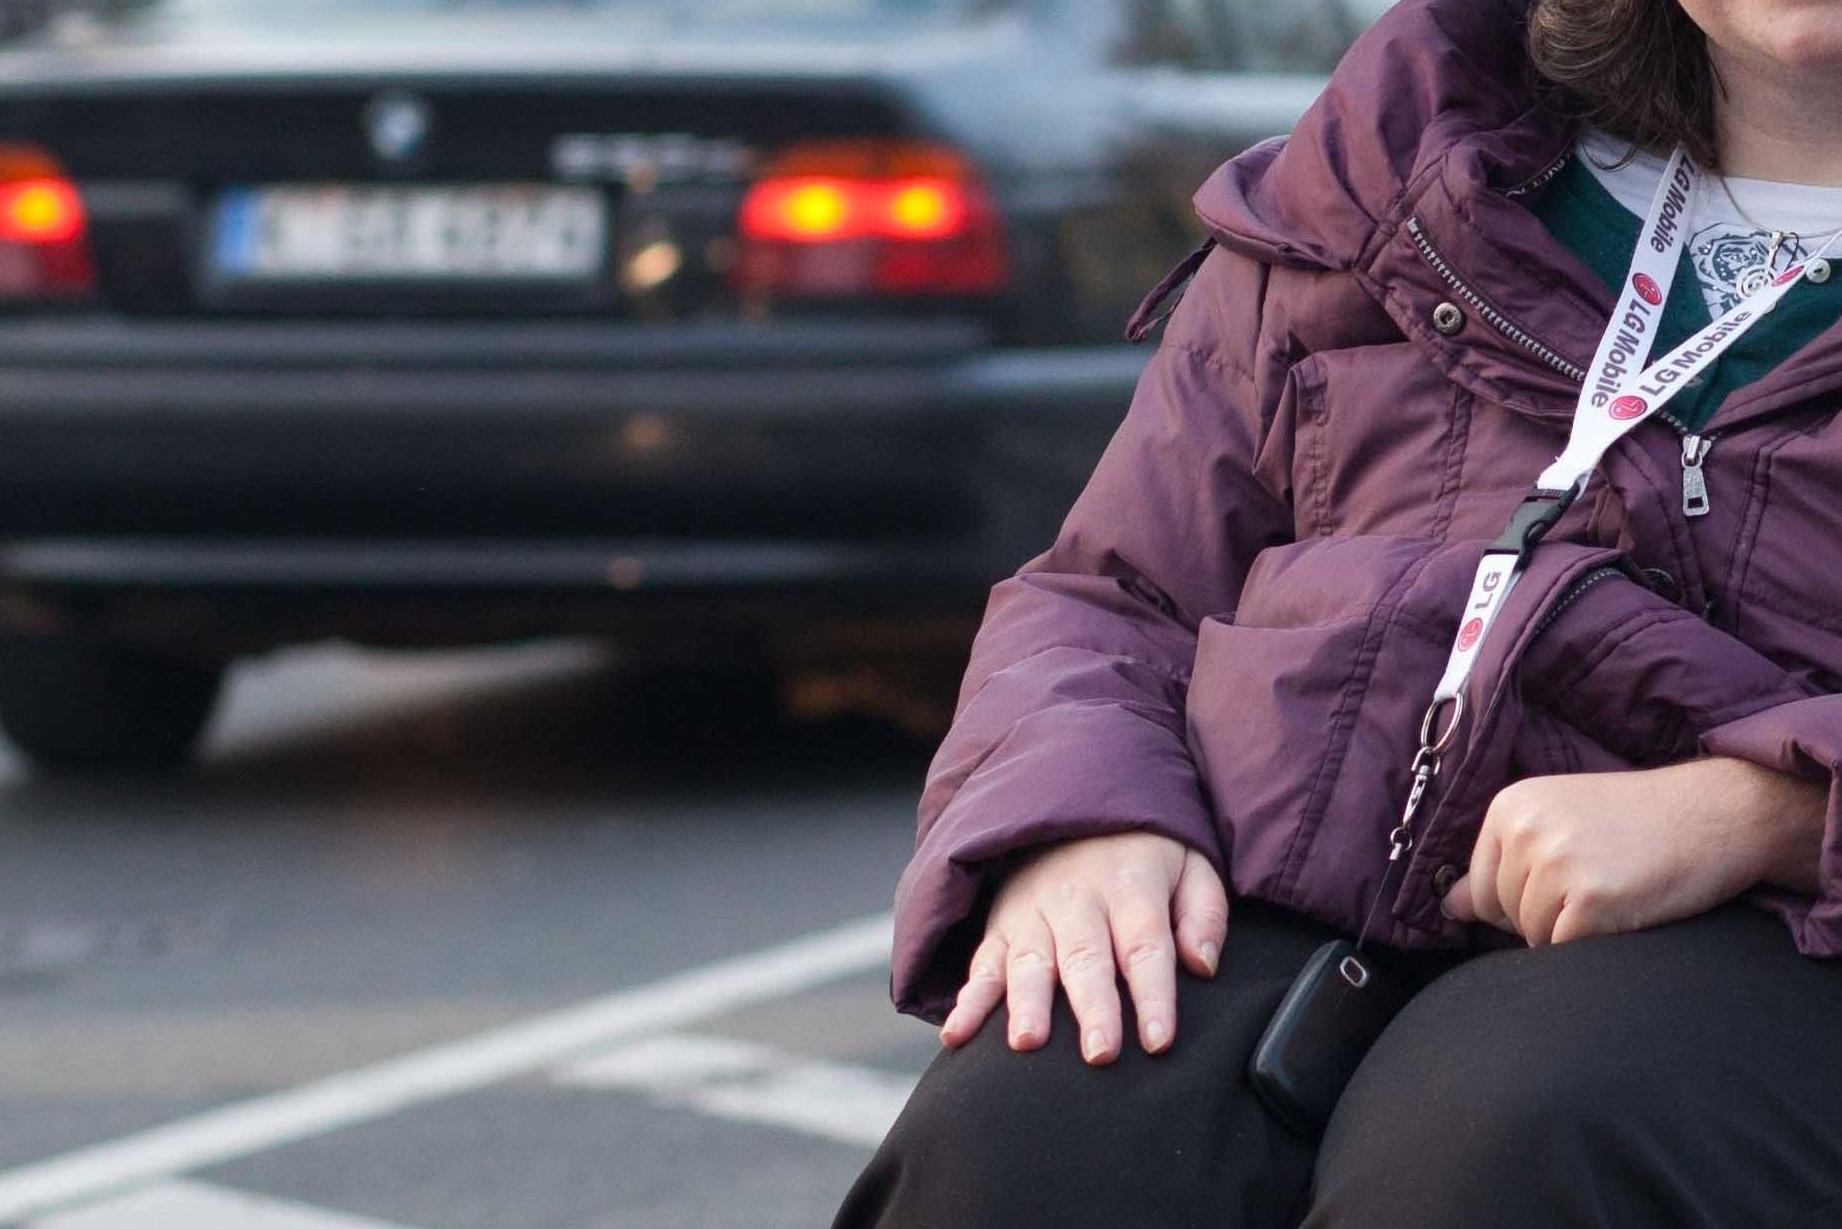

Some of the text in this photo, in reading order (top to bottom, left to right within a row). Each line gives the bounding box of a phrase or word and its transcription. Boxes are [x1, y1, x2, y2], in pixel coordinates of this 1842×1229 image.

[1650, 153, 1695, 253] LG Mobile
[1591, 299, 1651, 408] LG Mobile
[1640, 310, 1752, 397] LG Mobile
[1474, 571, 1502, 607] LG
